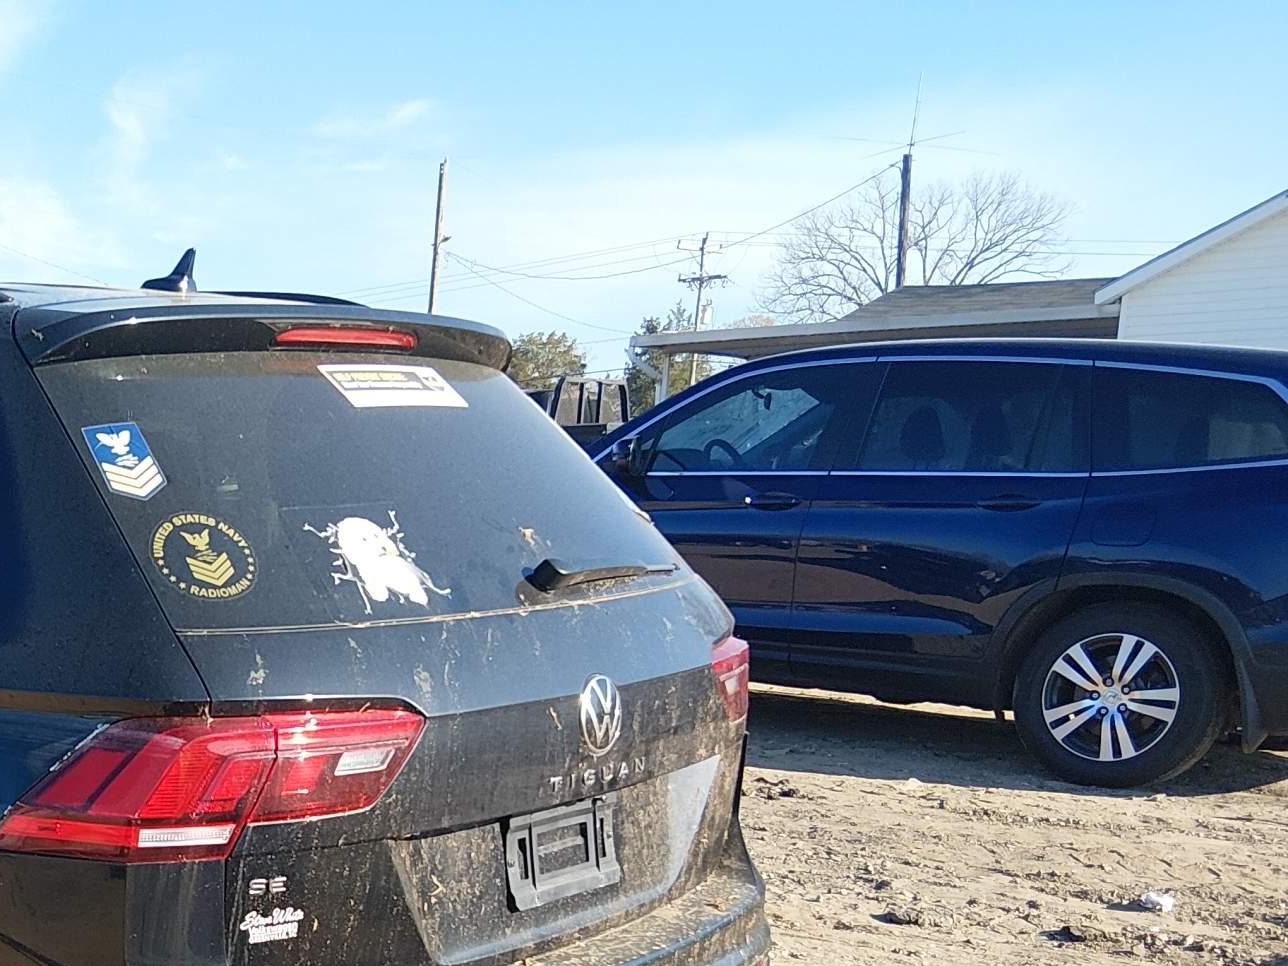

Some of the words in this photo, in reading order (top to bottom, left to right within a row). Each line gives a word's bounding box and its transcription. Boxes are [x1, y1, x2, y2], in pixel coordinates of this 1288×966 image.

[152, 522, 174, 558] UNITED
[172, 514, 216, 526] STATES
[217, 522, 249, 547] NAVY
[189, 577, 252, 598] RADIOMAN
[548, 756, 647, 793] TIGUAN
[248, 875, 288, 896] SE
